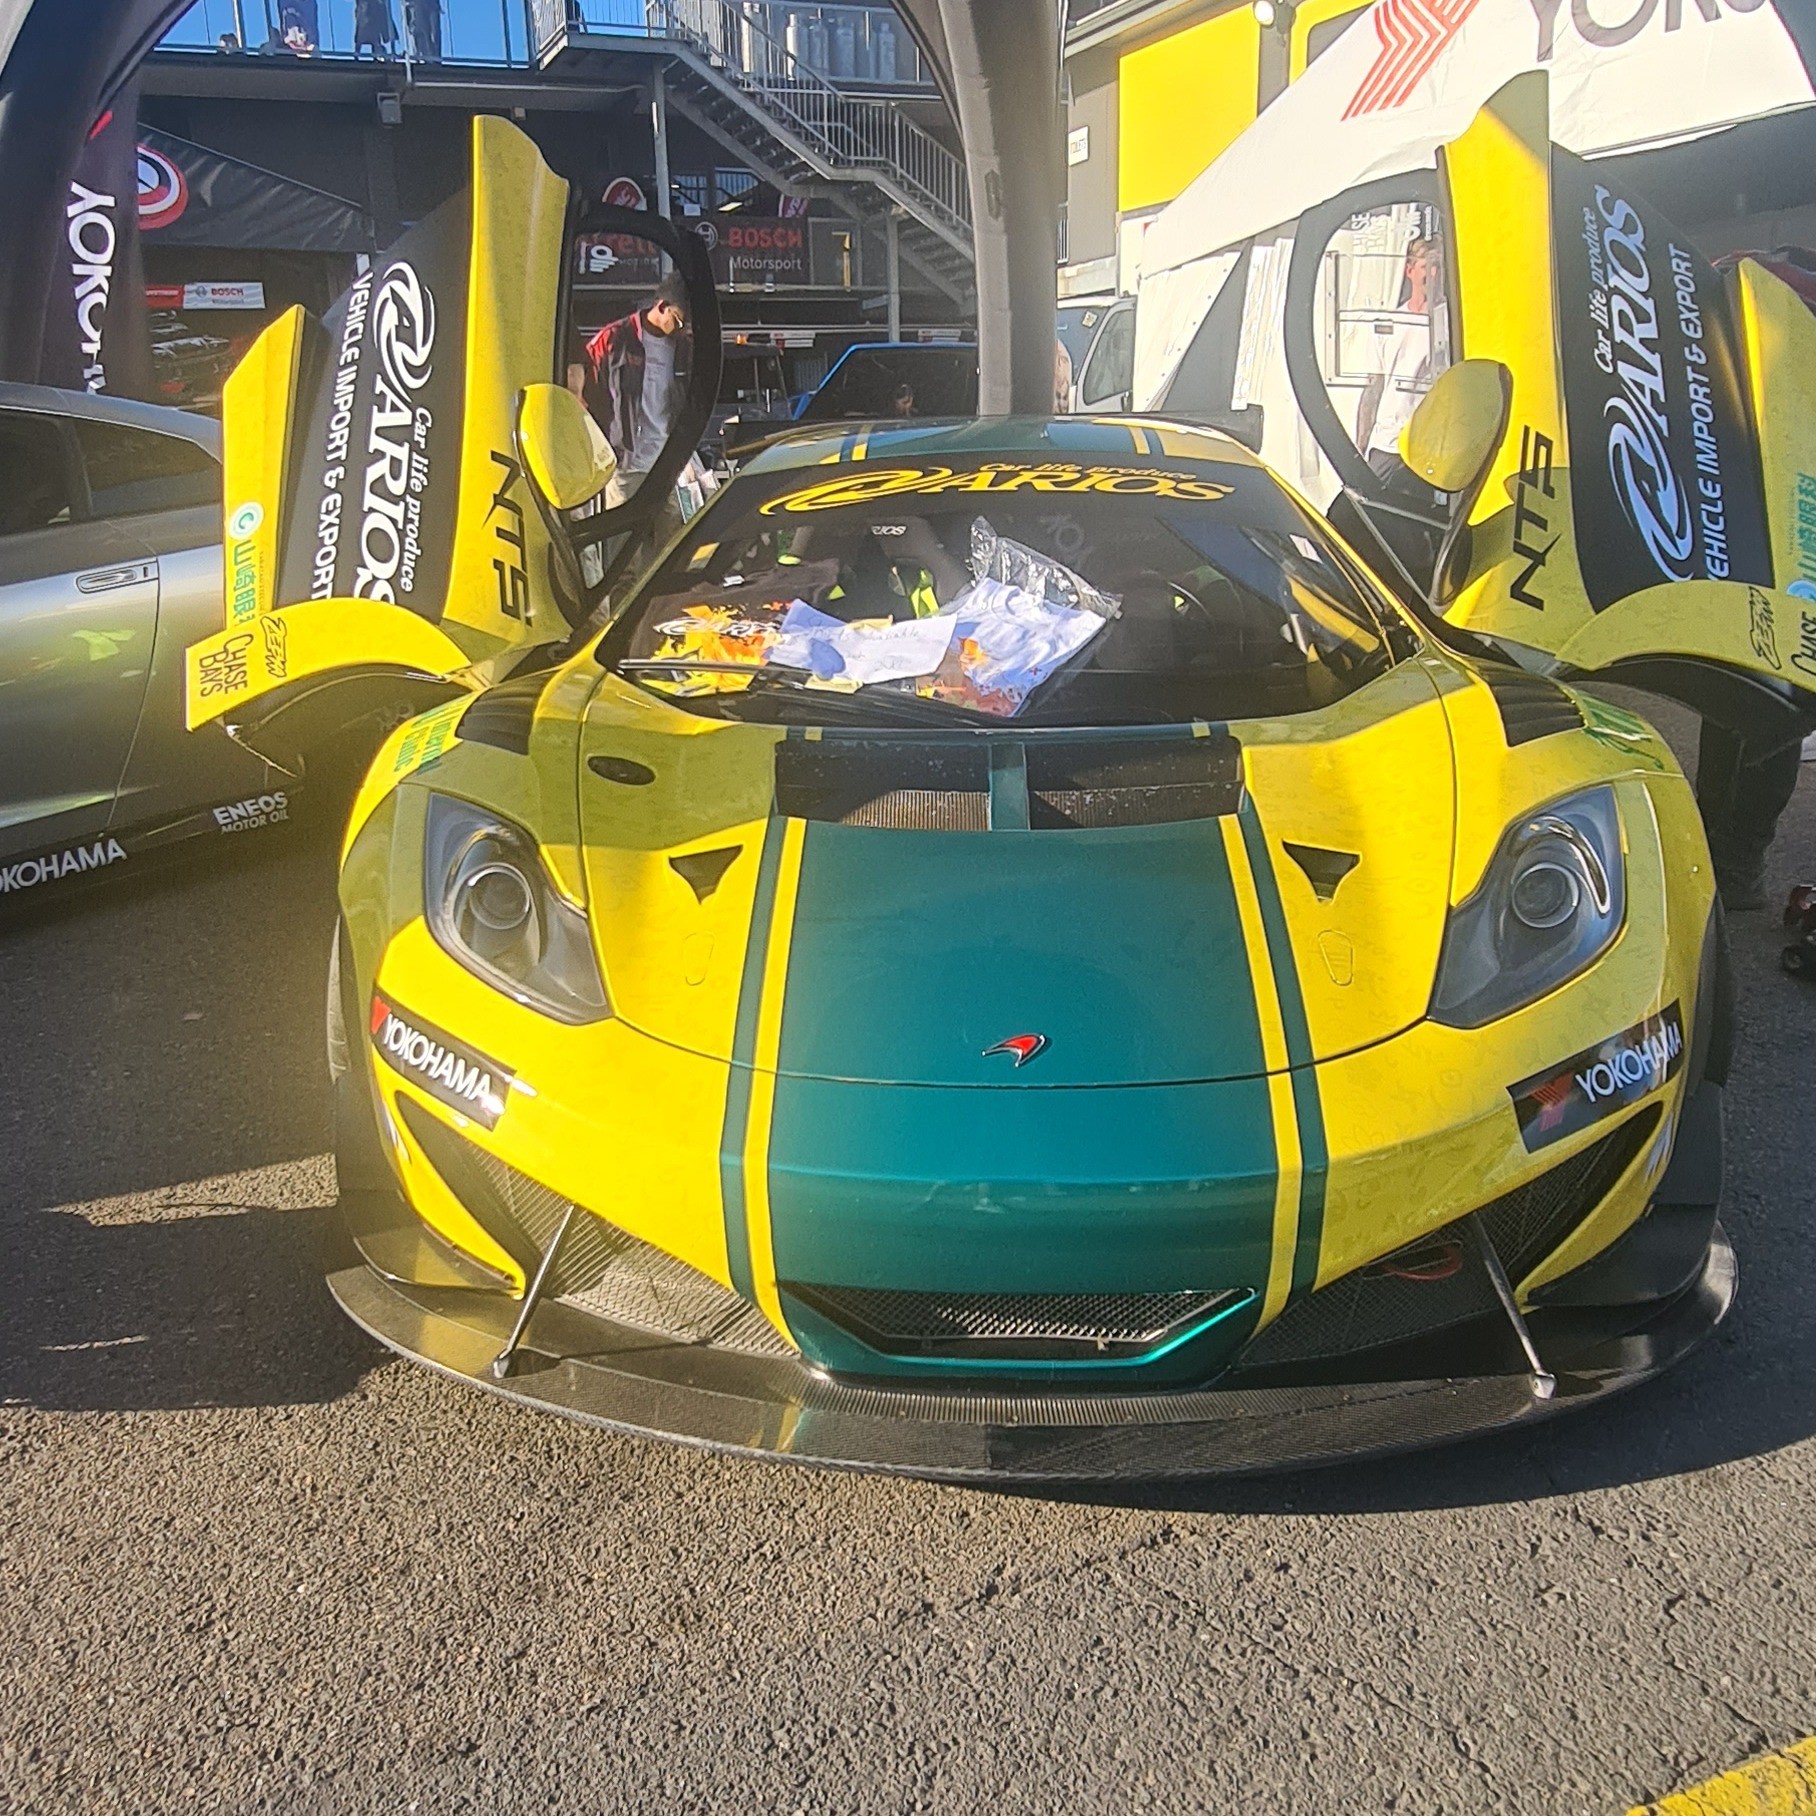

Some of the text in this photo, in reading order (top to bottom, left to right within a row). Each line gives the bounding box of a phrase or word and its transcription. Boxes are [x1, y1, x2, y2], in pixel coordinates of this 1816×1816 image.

[1530, 0, 1767, 61] YO
[729, 227, 801, 248] BOSCH
[731, 256, 801, 270] Motorsport
[211, 288, 244, 297] BOSCH
[1582, 207, 1614, 374] Car life produce
[311, 271, 374, 599] VEHICLE IMPORT & EXPORT
[1668, 243, 1731, 580] EHICLE IMPORT & EXPORT
[400, 407, 433, 592] Car life produce
[979, 463, 1198, 480] Car life produce
[233, 540, 257, 623] 山崎眼
[199, 650, 228, 698] BAYS
[224, 633, 254, 695] CHASE
[213, 792, 288, 825] ENEOS
[221, 808, 289, 834] MOTOR OIL
[383, 1012, 493, 1101] YOKOHAMA
[1575, 1021, 1683, 1102] YOKOHAMA
